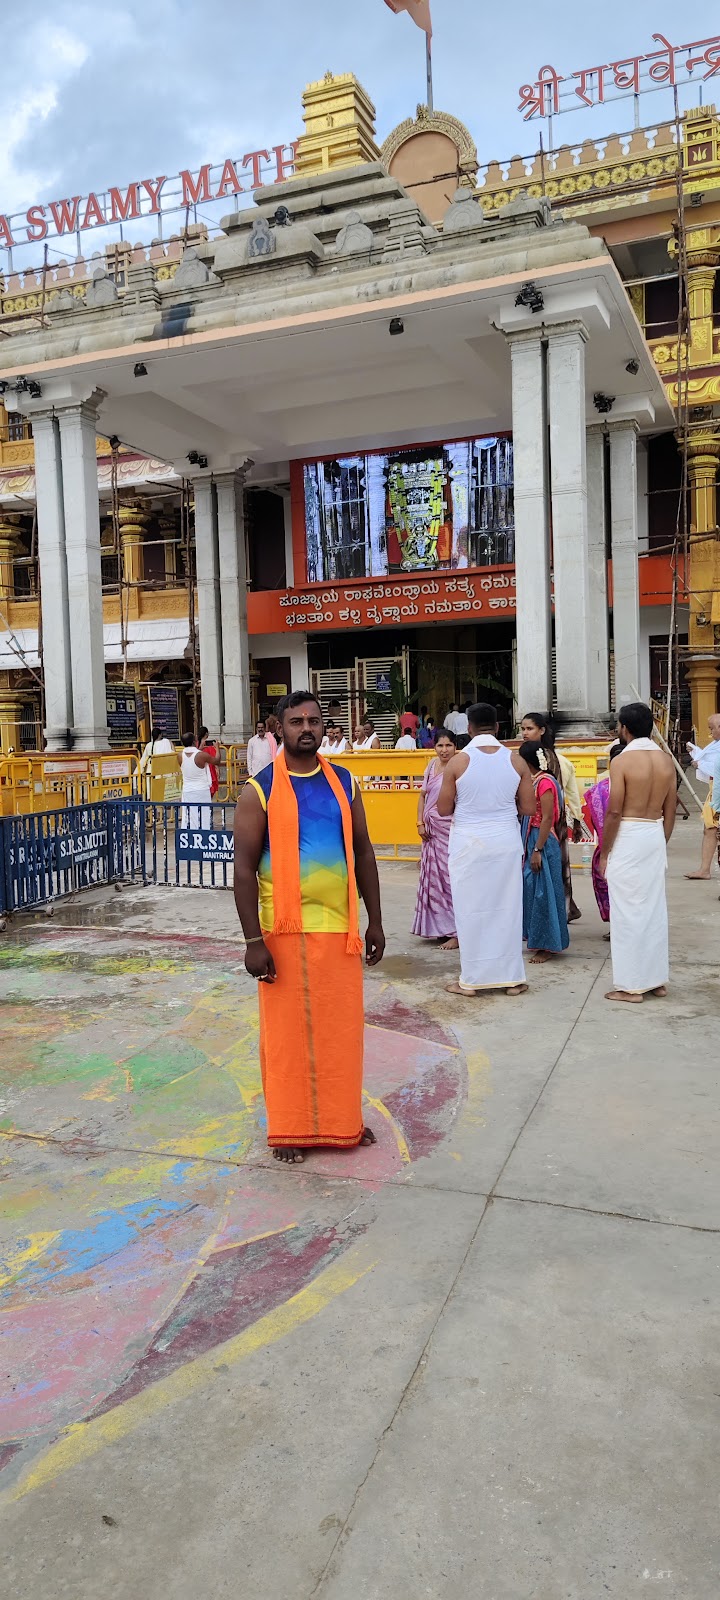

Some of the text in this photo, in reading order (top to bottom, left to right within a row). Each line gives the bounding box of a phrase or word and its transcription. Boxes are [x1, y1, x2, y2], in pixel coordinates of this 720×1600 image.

[517, 64, 565, 122] श्री
[26, 175, 168, 242] SWAMY
[179, 832, 234, 851] S.R.S.M
[202, 851, 234, 860] MANTRALA
